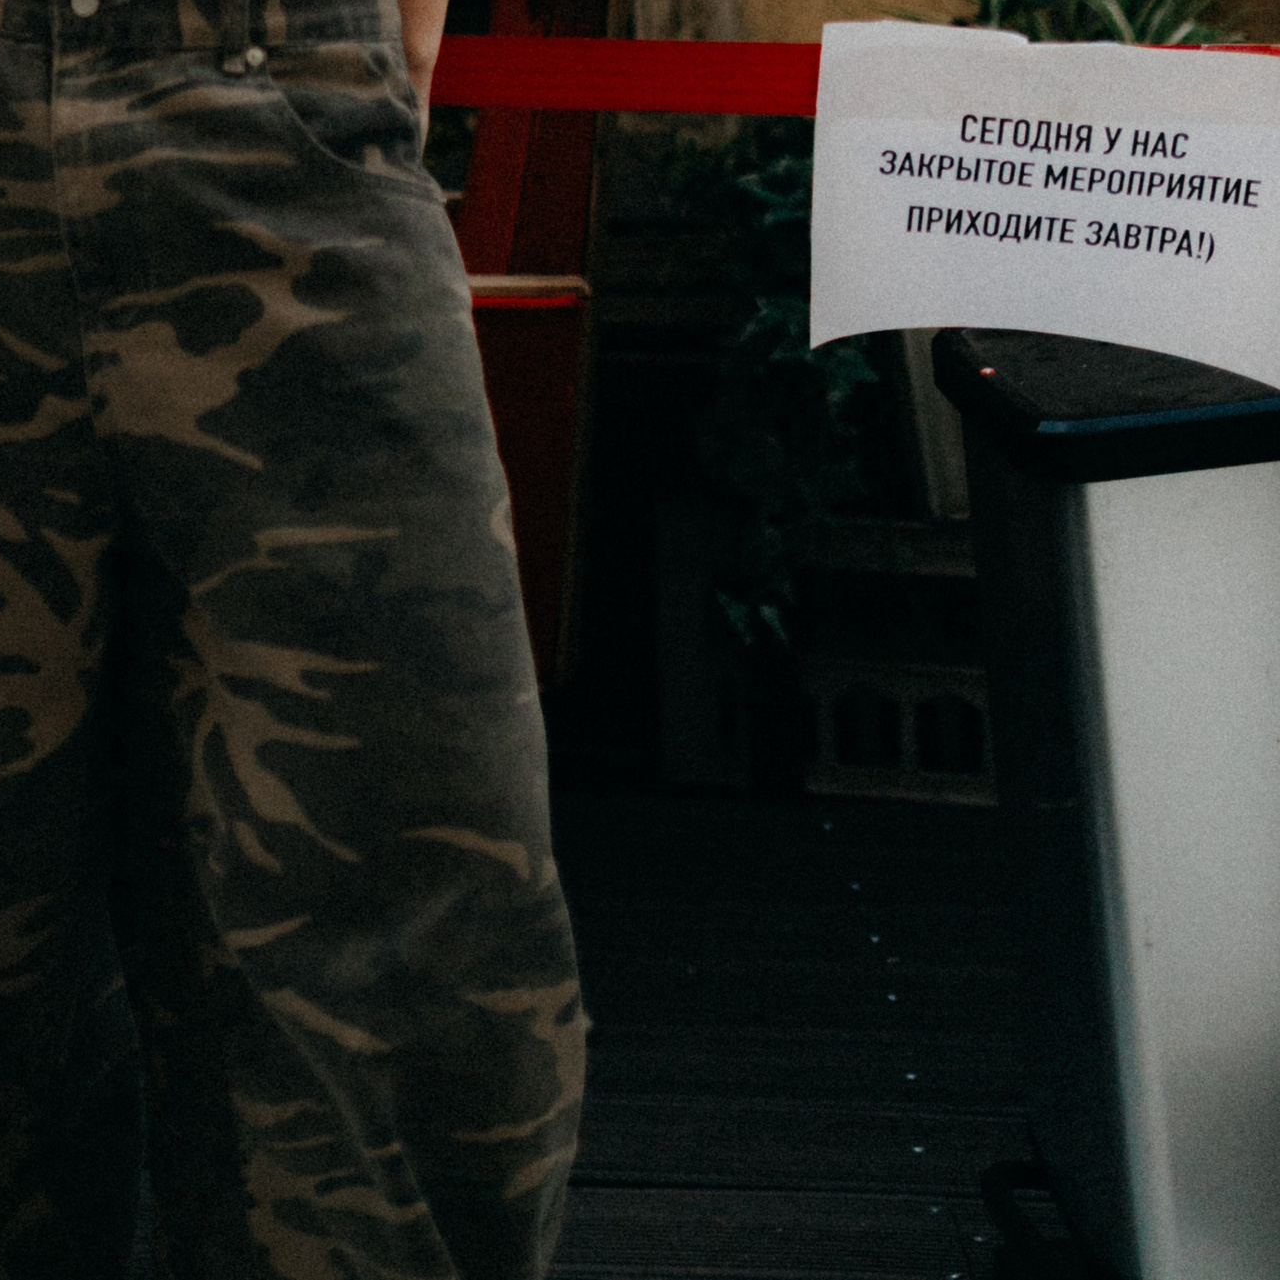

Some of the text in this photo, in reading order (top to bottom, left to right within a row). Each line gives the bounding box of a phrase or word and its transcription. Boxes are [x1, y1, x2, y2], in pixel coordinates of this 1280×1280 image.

[960, 114, 1190, 159] СЕГОДНЯ У НАС
[879, 149, 1261, 208] ЗАКРЫТОЕ МЕРОПРИЯТИЕ
[906, 205, 1216, 263] ПРИХОДИТЕ ЗАВТРА!)
